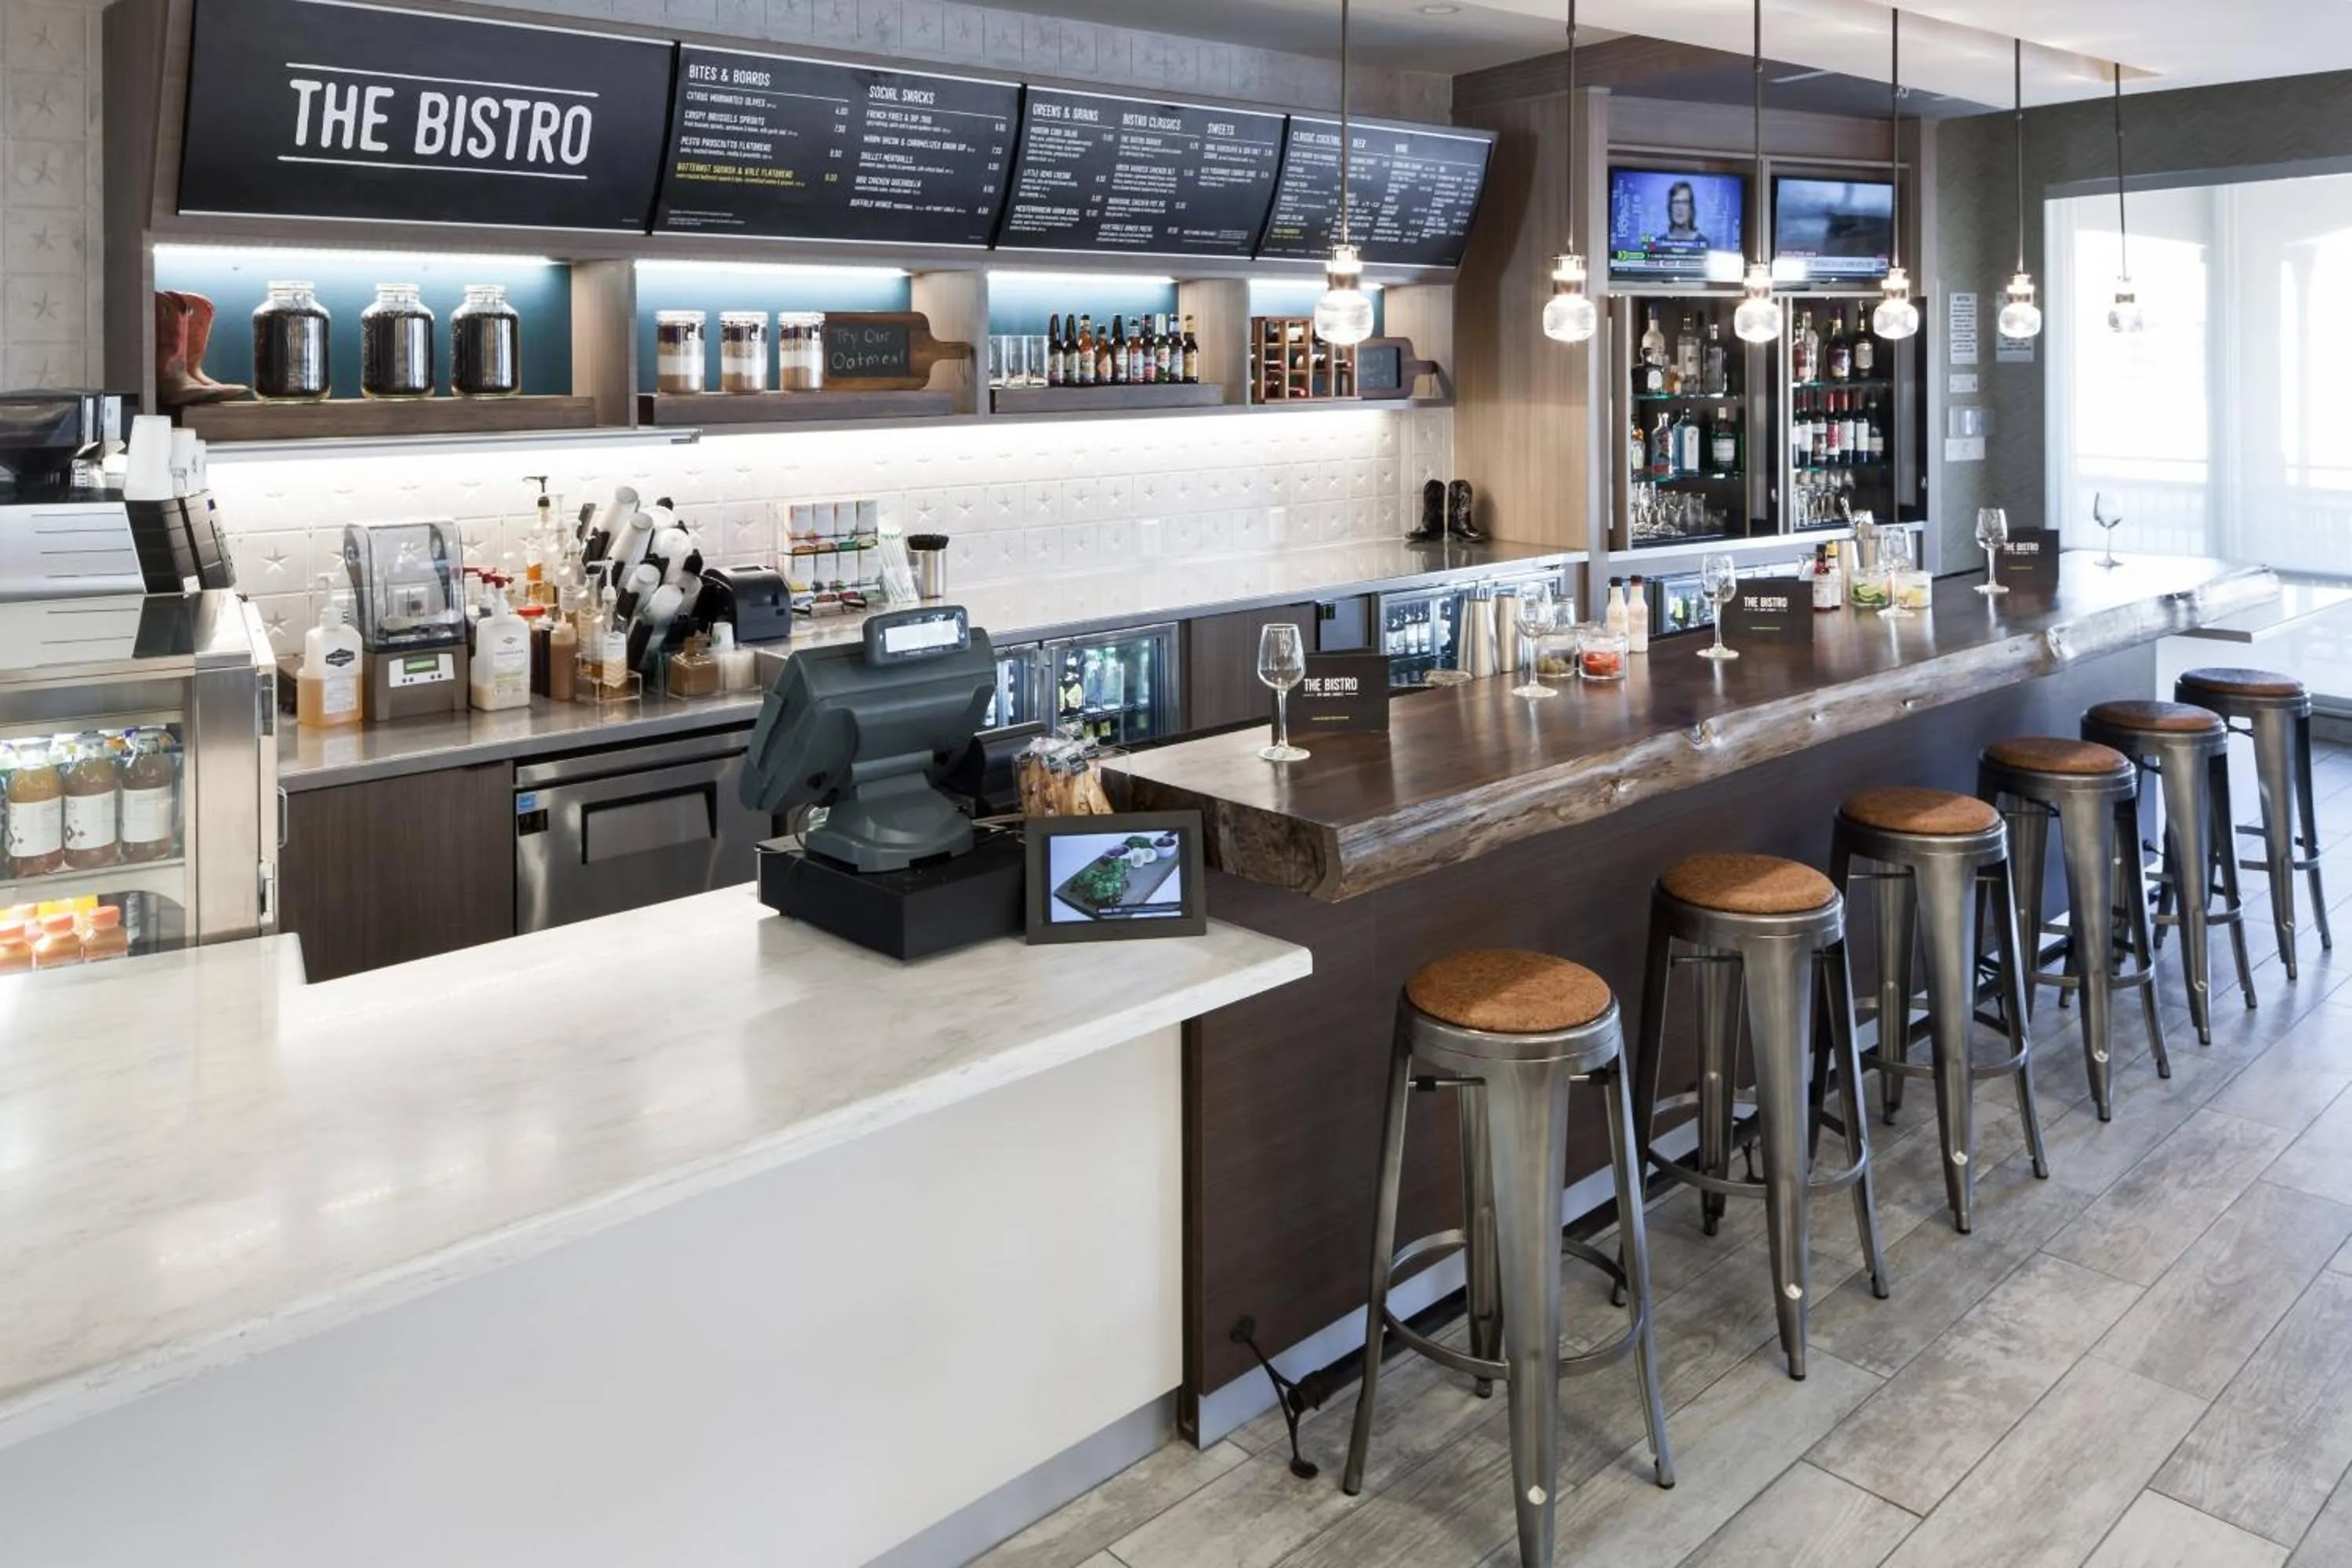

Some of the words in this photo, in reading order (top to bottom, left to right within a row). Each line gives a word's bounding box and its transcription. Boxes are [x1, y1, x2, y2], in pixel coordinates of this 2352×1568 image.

[689, 64, 717, 81] BITES
[720, 68, 729, 82] &
[733, 70, 771, 87] BOARDS
[869, 85, 898, 101] SOCIAL
[902, 89, 935, 104] SNACKS
[289, 79, 395, 152] THE
[414, 91, 593, 166] BISTRO
[837, 328, 857, 350] Try
[865, 328, 891, 343] Our
[832, 350, 905, 371] Oatmeal
[1744, 597, 1758, 608] THE
[1760, 597, 1788, 608] BISTRO
[1304, 678, 1322, 691] THE
[1324, 677, 1358, 691] BISTRO
